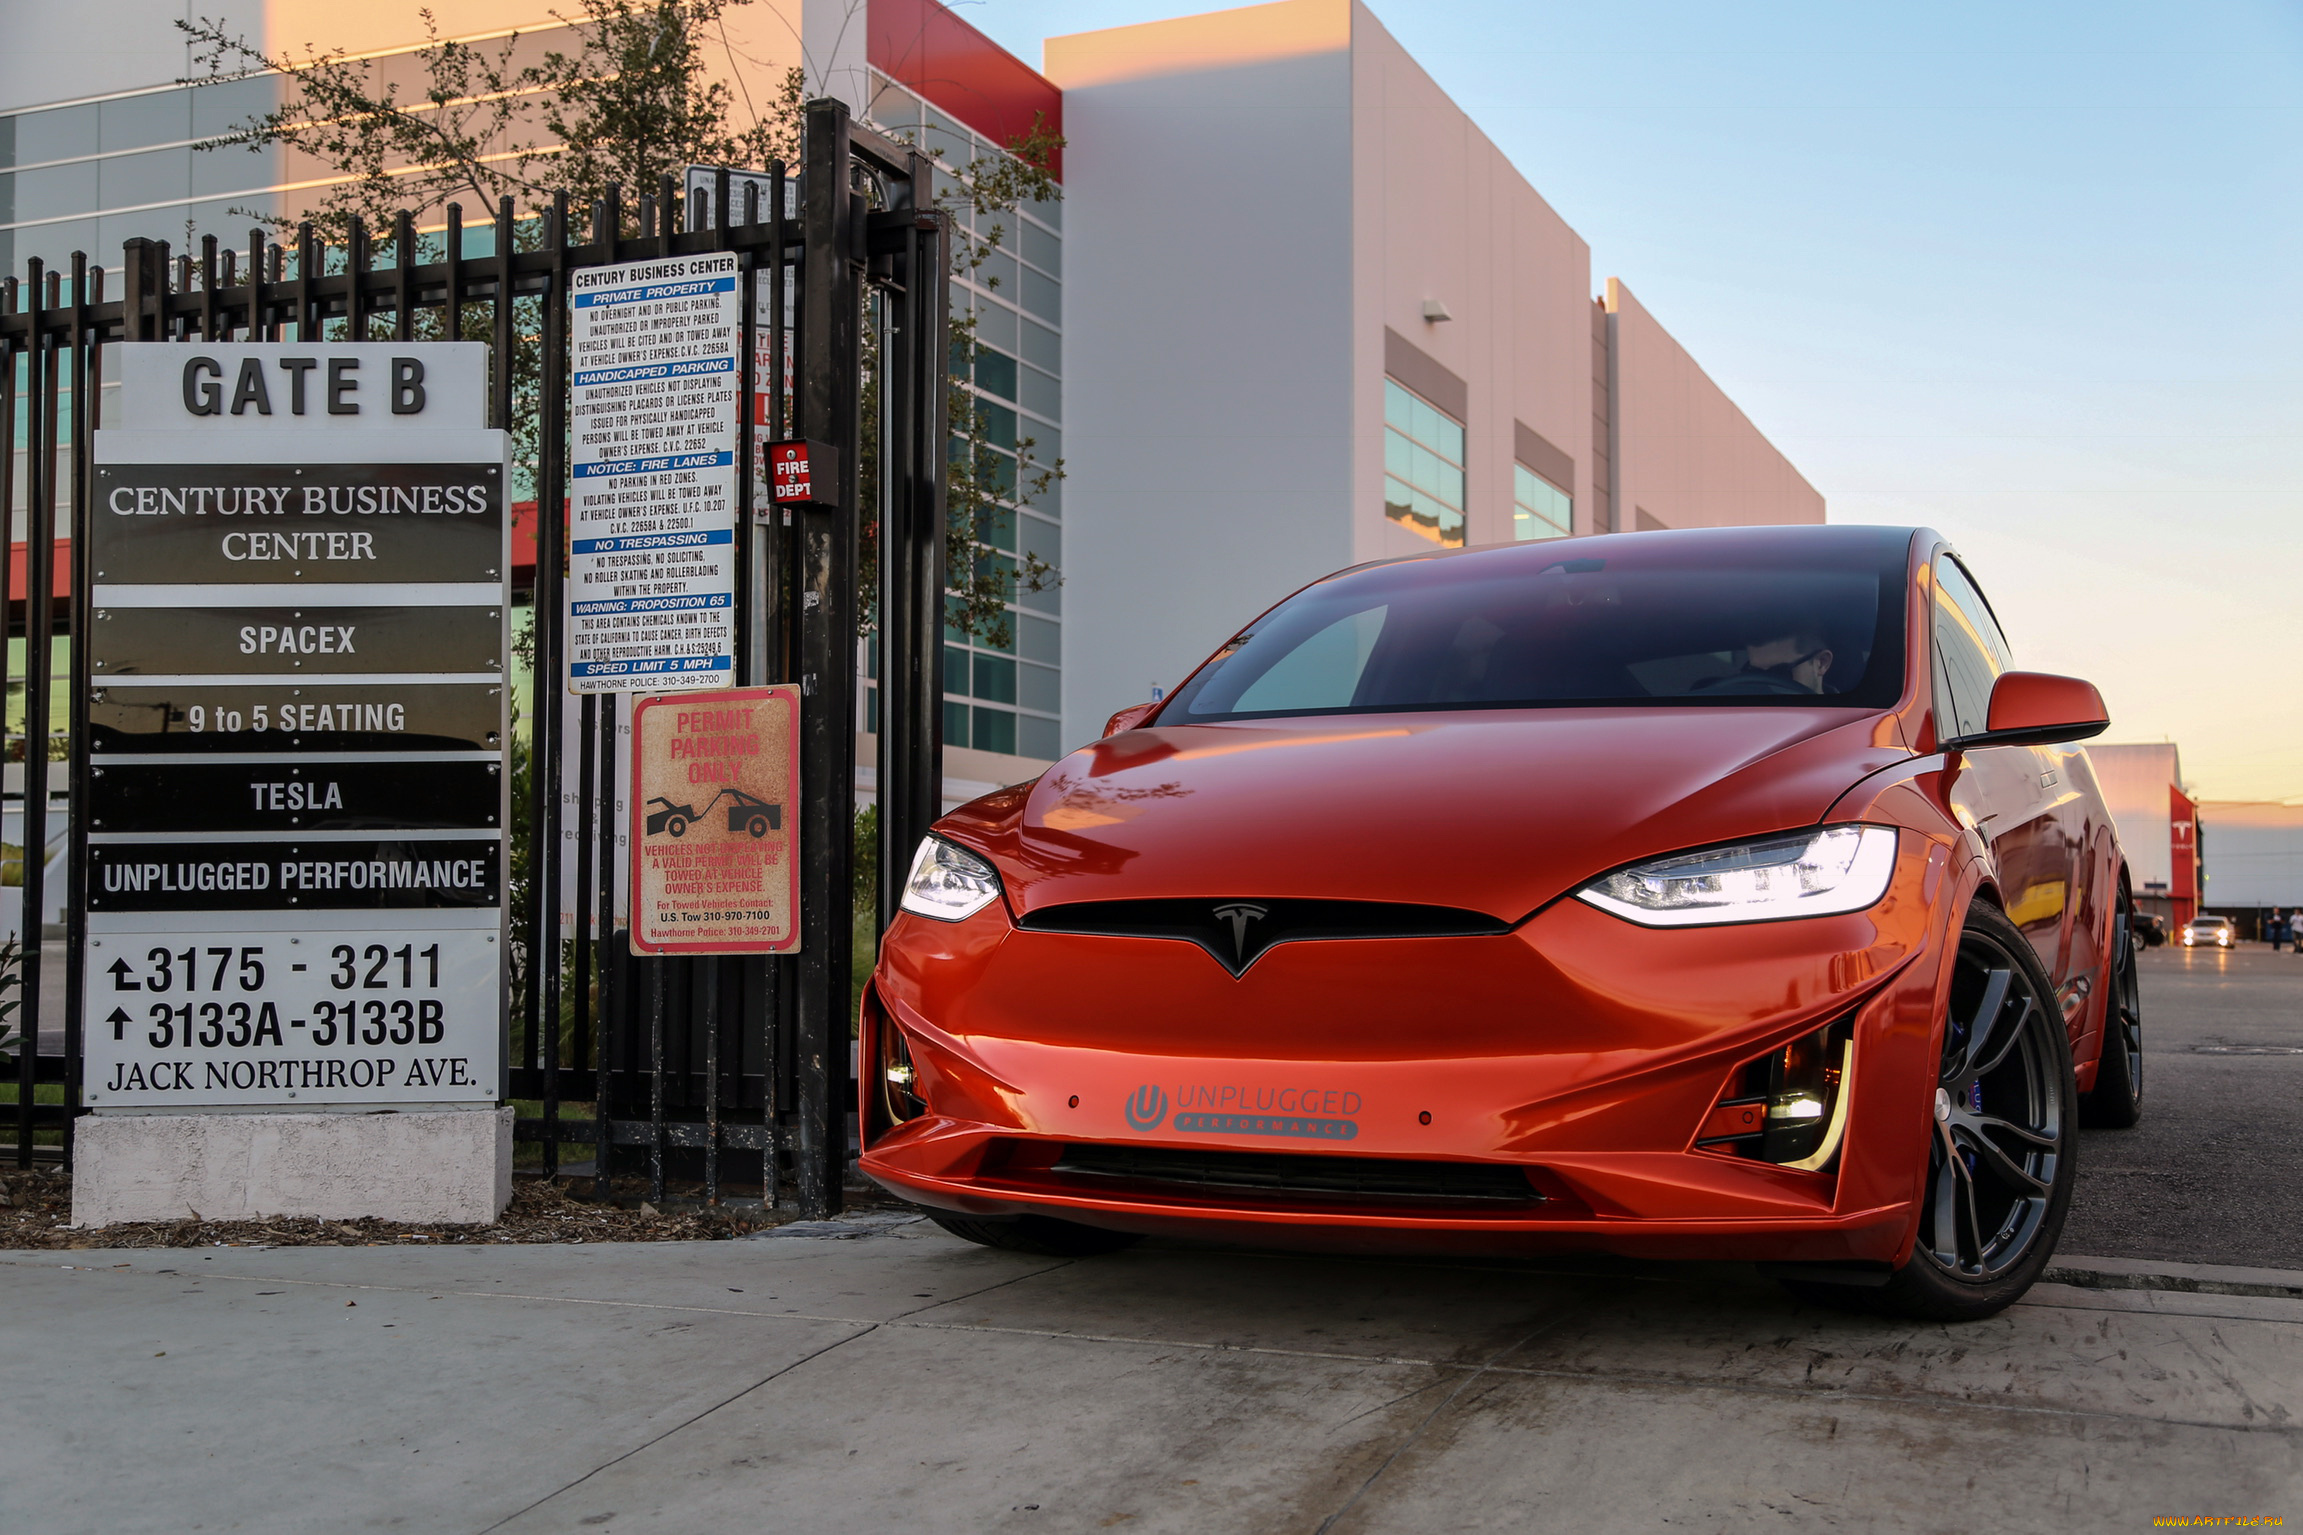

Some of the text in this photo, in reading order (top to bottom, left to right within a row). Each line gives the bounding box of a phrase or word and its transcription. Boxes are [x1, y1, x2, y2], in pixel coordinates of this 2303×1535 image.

[576, 258, 734, 288] CENTURY BUSINESS CENTER
[593, 282, 715, 304] PRIVATE PROPERTY
[590, 310, 598, 322] NO
[601, 307, 635, 320] OVERNIGHT
[639, 305, 651, 317] AND
[655, 304, 663, 315] OR
[666, 301, 688, 314] PUBLIC
[590, 313, 719, 336] UNAUTHORIZED OR IMPROPERLY PARKED
[579, 327, 731, 352] VEHICLES WILL BE CITED AND OR TOWED AWAY
[579, 366, 667, 384] HANDICAPPED
[672, 360, 728, 375] PARKING
[182, 356, 426, 416] GATE B
[586, 377, 721, 400] UNAUTHORIZED VEHICLES NOT DISPLAYING
[575, 391, 732, 416] DISTINGUISHING PLACARDS OR LICENSE PLATES
[591, 407, 715, 429] ISSUED FOR PHYSICALLY HANDICAPPED
[583, 422, 724, 445] PERSONS WILL BE TOWED AWAY AT VEHICLE
[599, 445, 627, 458] OWNER'S
[631, 442, 660, 455] EXPENSE.
[685, 438, 706, 450] 22652
[587, 455, 717, 475] NOTICE: FIRE LANES
[776, 460, 809, 476] FIRE
[609, 479, 617, 489] NO
[620, 476, 647, 488] PARKING
[651, 475, 657, 486] IN
[660, 474, 672, 485] RED
[776, 482, 811, 498] DEPT
[108, 485, 488, 516] CENTURY BUSINESS
[583, 485, 722, 506] VIOLATING VEHICLES WILL BE TOWED AWAY
[580, 510, 587, 521] AT
[591, 508, 615, 520] VEHICLE
[618, 506, 646, 518] OWNER'S
[650, 503, 680, 516] EXPENSE.
[704, 500, 725, 512] 10.207
[610, 518, 693, 534] C.V.C. 22658A & 22500.1
[222, 532, 377, 561] CENTER
[595, 533, 707, 550] NO TRESPASSING
[597, 557, 605, 568] NO
[656, 553, 664, 564] NO
[584, 565, 718, 584] NO ROLLER SKATING AND ROLLERBLADING
[614, 585, 635, 596] WITHIN
[639, 584, 650, 595] THE
[576, 596, 725, 614] WARNING: PROPOSITION 65
[239, 626, 356, 655] SPACEX
[587, 659, 712, 674] SPEED LIMIT 5 MPH
[581, 675, 719, 689] HAWTHORNE POLICE: 310-349-2700
[189, 703, 405, 733] 9 to 5 SEATING
[678, 709, 754, 733] PERMIT
[671, 734, 760, 759] PARKING
[688, 761, 742, 784] ONLY
[250, 782, 343, 810] TESLA
[645, 841, 783, 856] VEHICLES NOT DISPLAYING
[652, 854, 778, 869] A VALID PERMIT WILL BE
[104, 859, 485, 892] UNPLUGGED PERFORMANCE
[665, 868, 763, 881] TOWED AT VEHICLE
[665, 881, 765, 894] OWNER'S EXPENSE.
[657, 899, 773, 910] For Towed Vehicles Contact:
[661, 911, 770, 922] U.S. Tow 310-970-7100
[651, 926, 780, 937] Hawthorne Police: 310-349-2701
[146, 946, 265, 993] 3175
[330, 943, 440, 990] 3211
[107, 1057, 476, 1091] JACK NORTHROP AVE.
[1176, 1084, 1362, 1115] UNPLUGGED
[1183, 1117, 1348, 1135] PERFORMANCE
